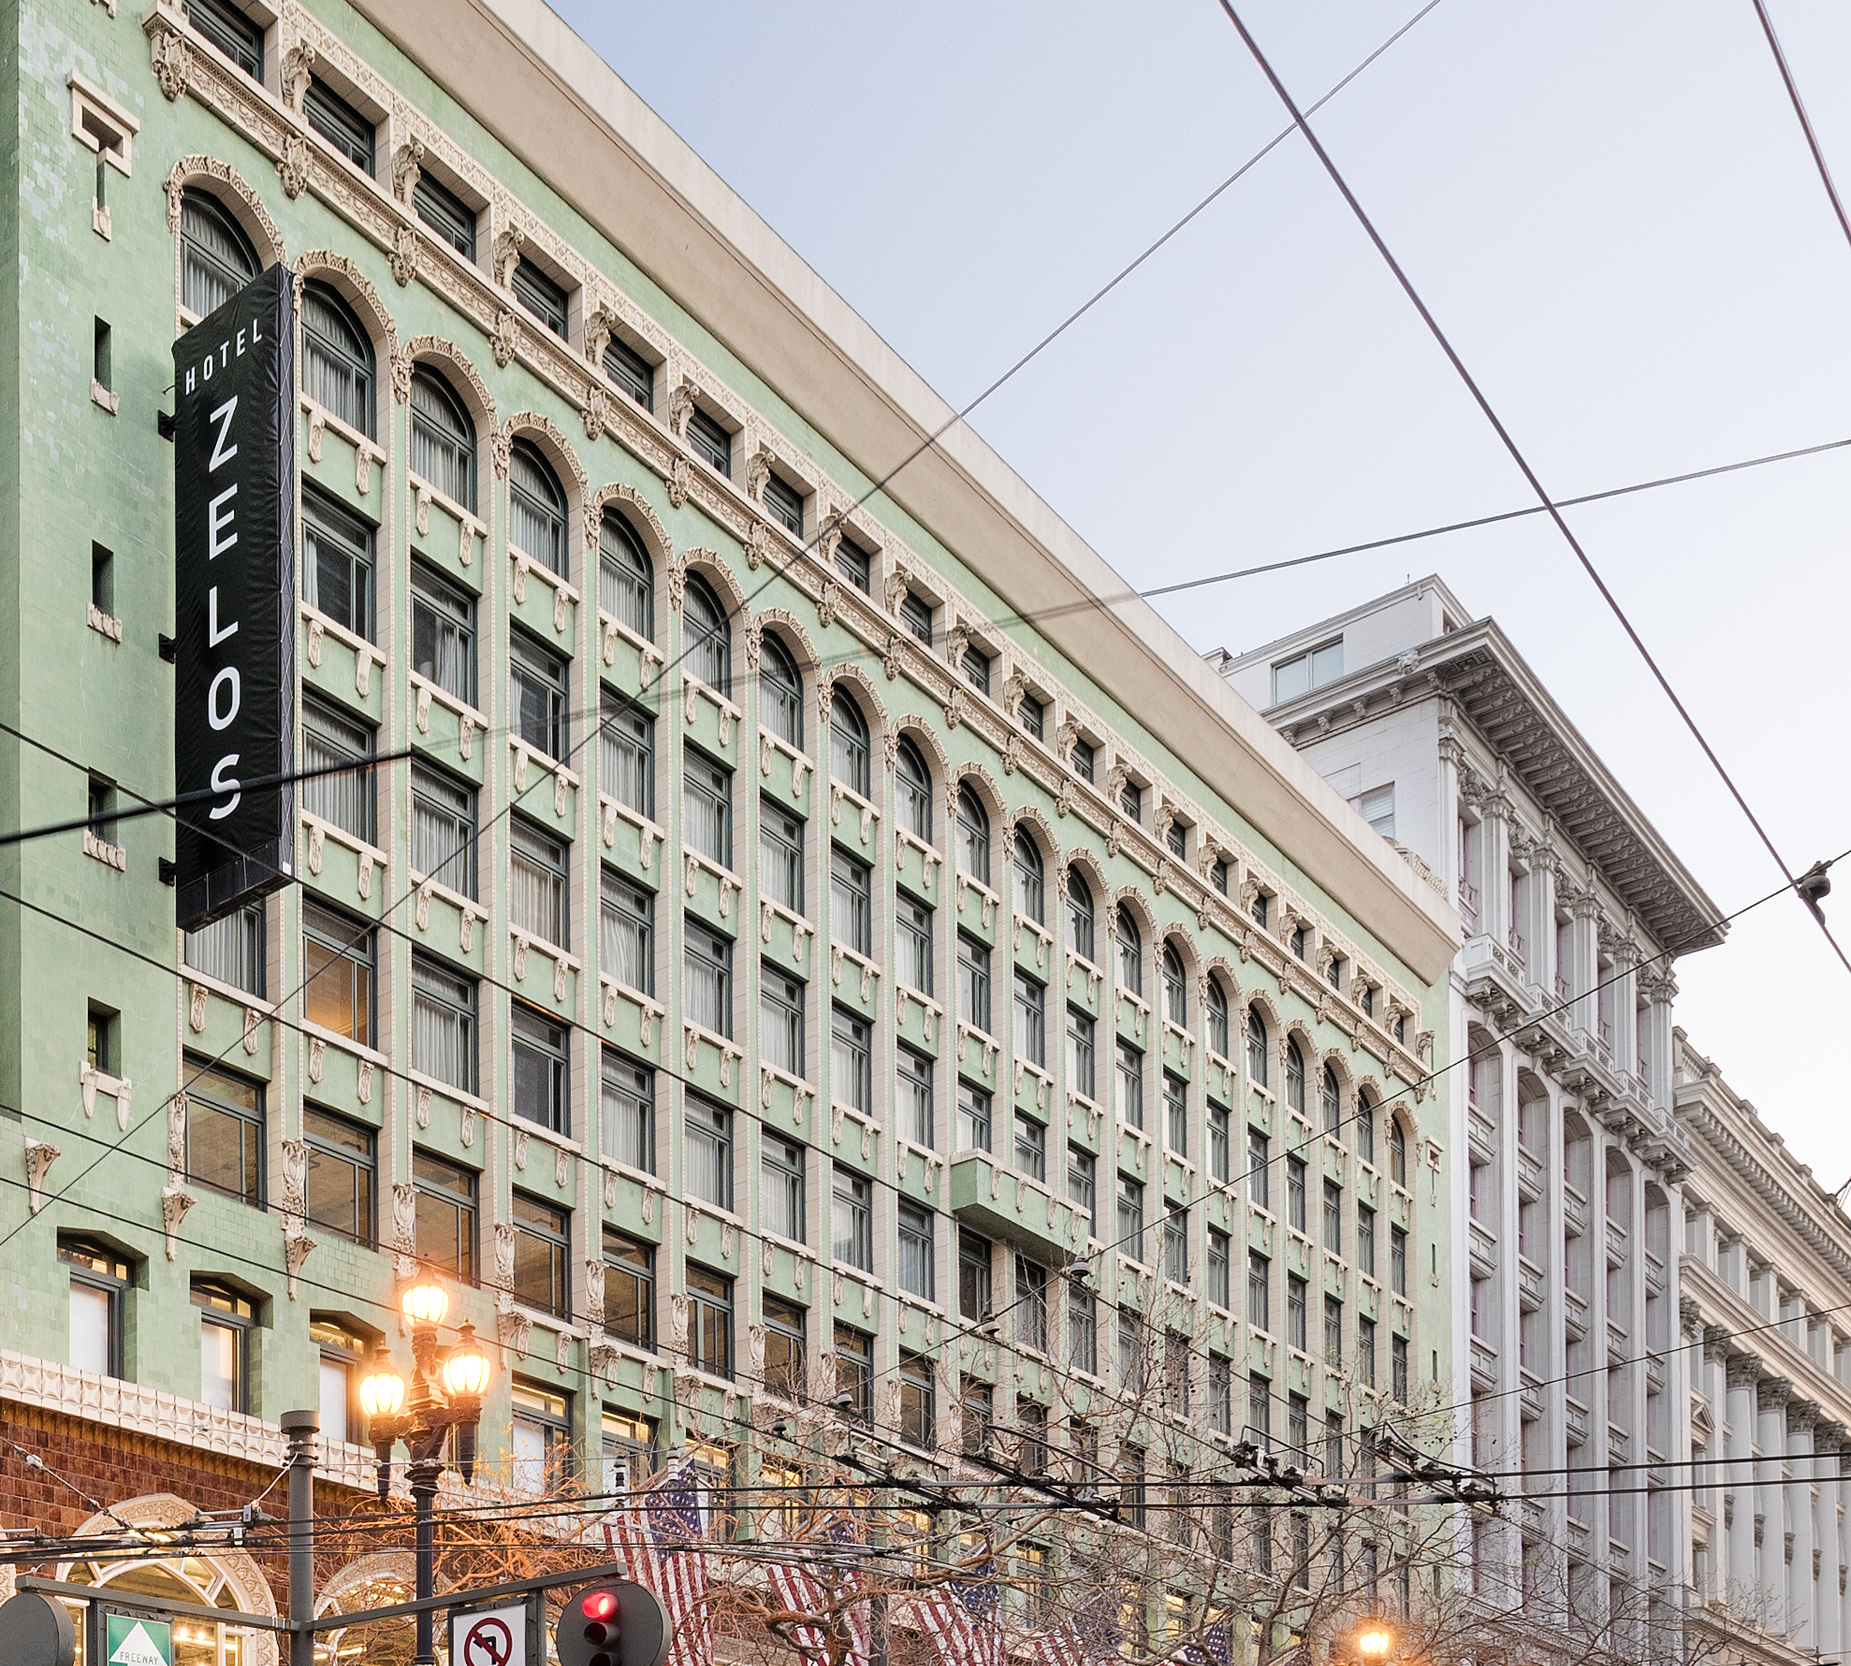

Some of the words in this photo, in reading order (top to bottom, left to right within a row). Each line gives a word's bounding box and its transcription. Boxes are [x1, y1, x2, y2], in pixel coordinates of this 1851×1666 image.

[184, 318, 264, 393] HOTEL
[208, 395, 242, 820] ZELOS
[120, 1651, 159, 1665] FREEWAY
